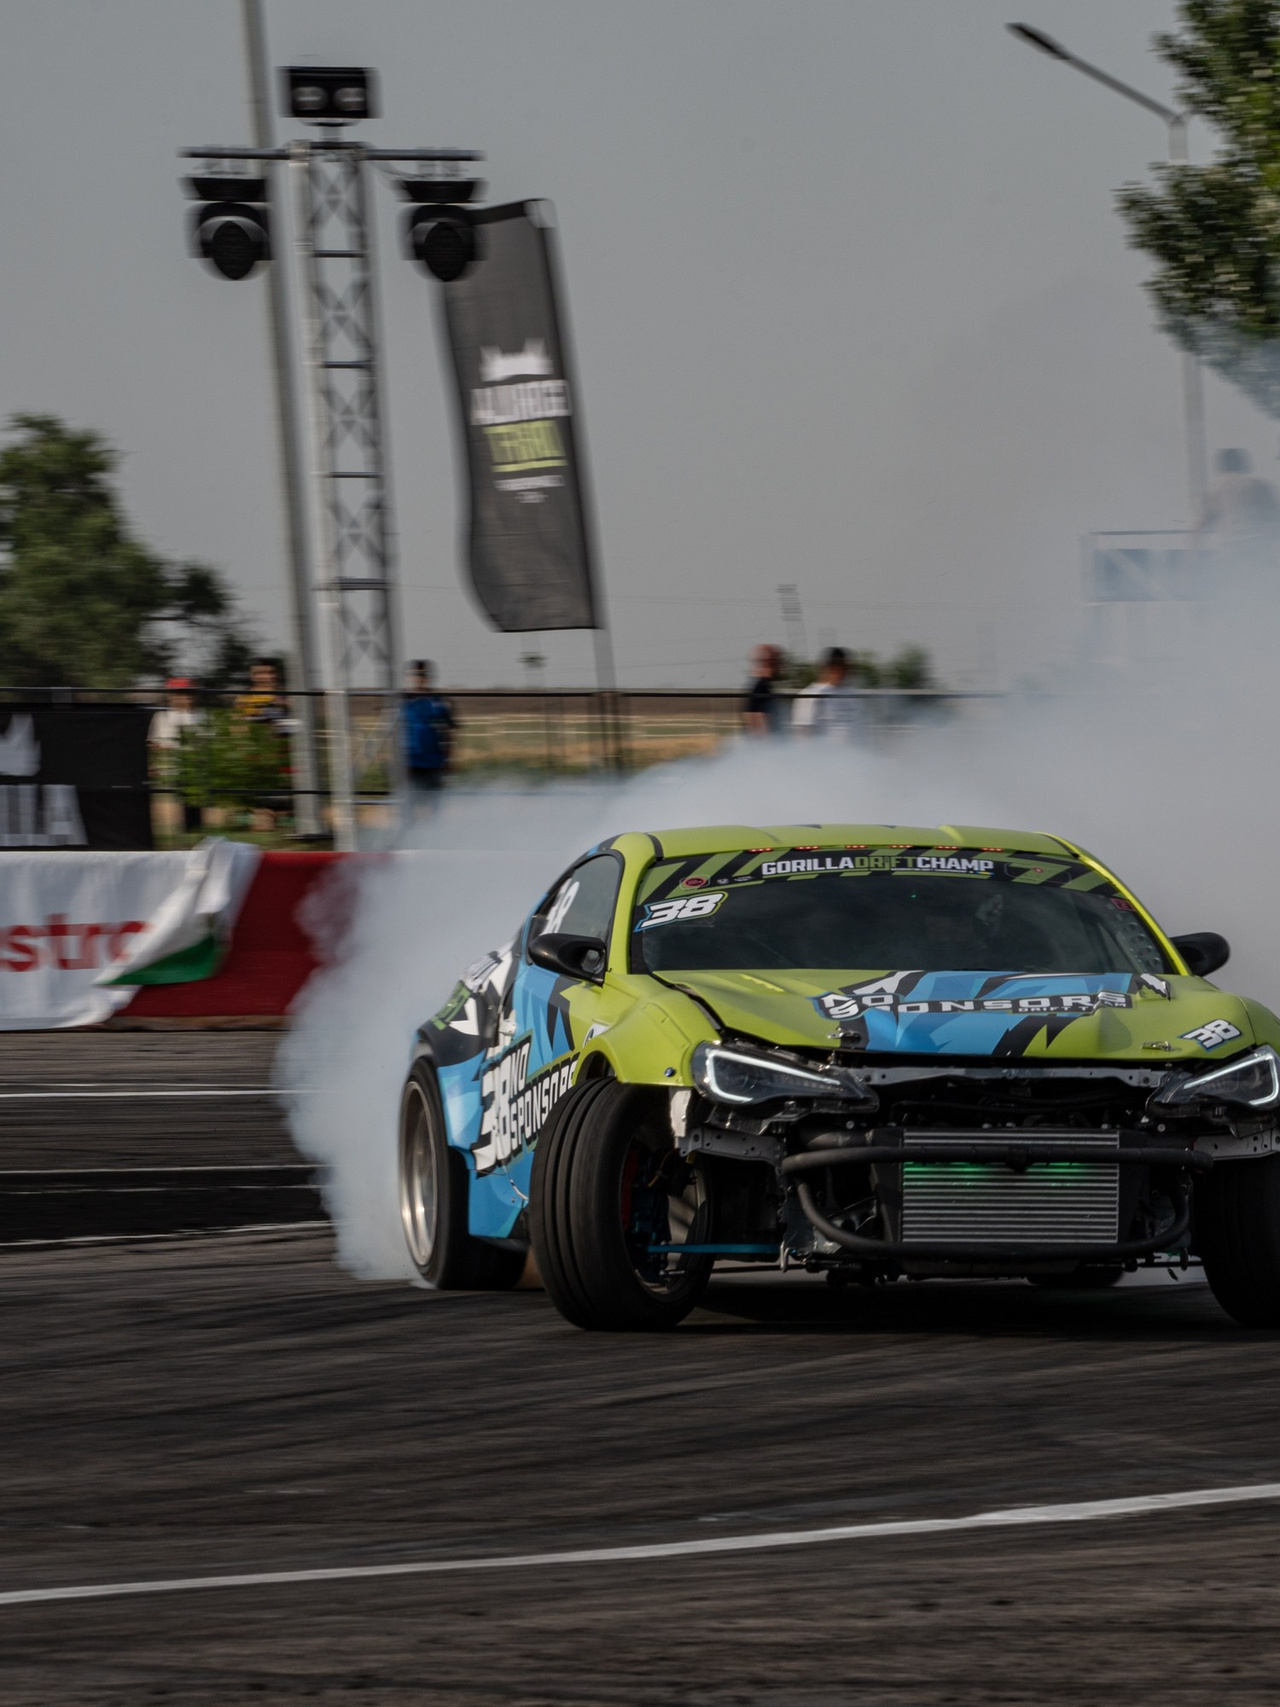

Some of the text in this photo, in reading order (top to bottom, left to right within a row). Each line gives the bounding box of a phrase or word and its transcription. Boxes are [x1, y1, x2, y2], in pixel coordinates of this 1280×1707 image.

[640, 893, 724, 928] 38
[828, 991, 1126, 1019] SONSORS
[1182, 1019, 1241, 1048] 38
[511, 1043, 531, 1098] NO
